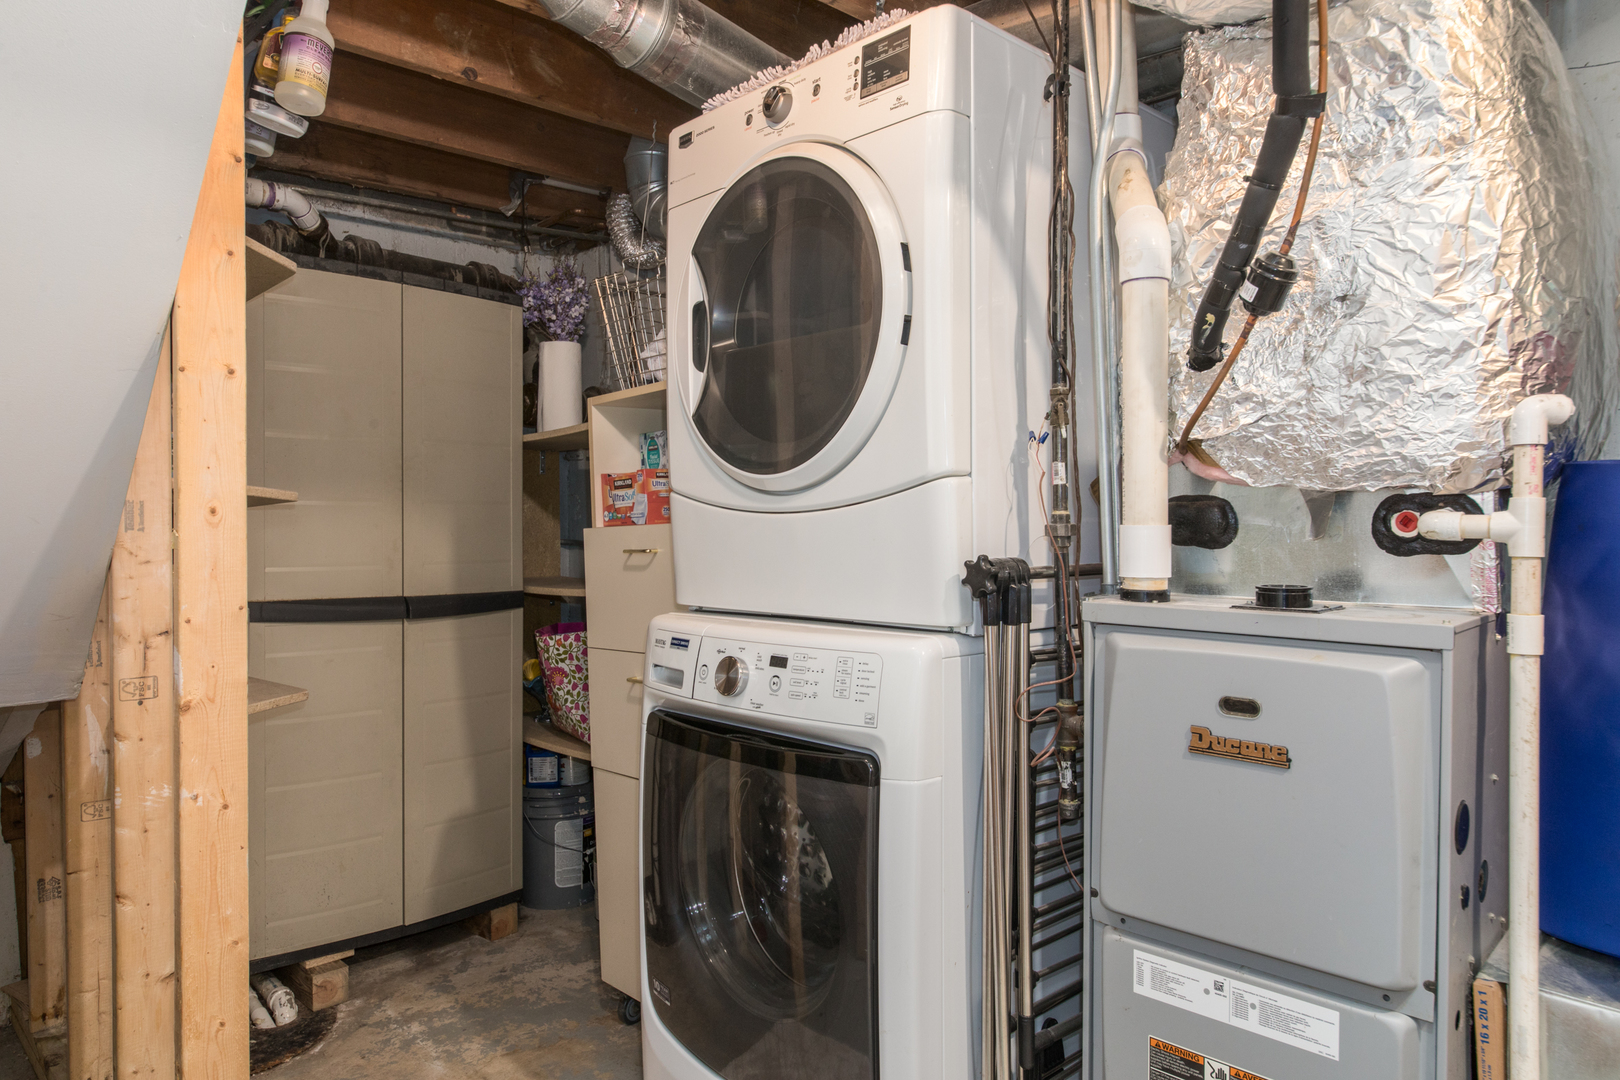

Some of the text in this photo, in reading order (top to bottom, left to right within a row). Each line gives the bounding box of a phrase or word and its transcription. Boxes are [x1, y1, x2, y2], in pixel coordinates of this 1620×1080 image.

[744, 108, 755, 116] power
[1188, 724, 1289, 763] Ducane
[1479, 1007, 1489, 1022] 20
[1480, 1032, 1490, 1045] 16
[1161, 1043, 1201, 1063] WARNING
